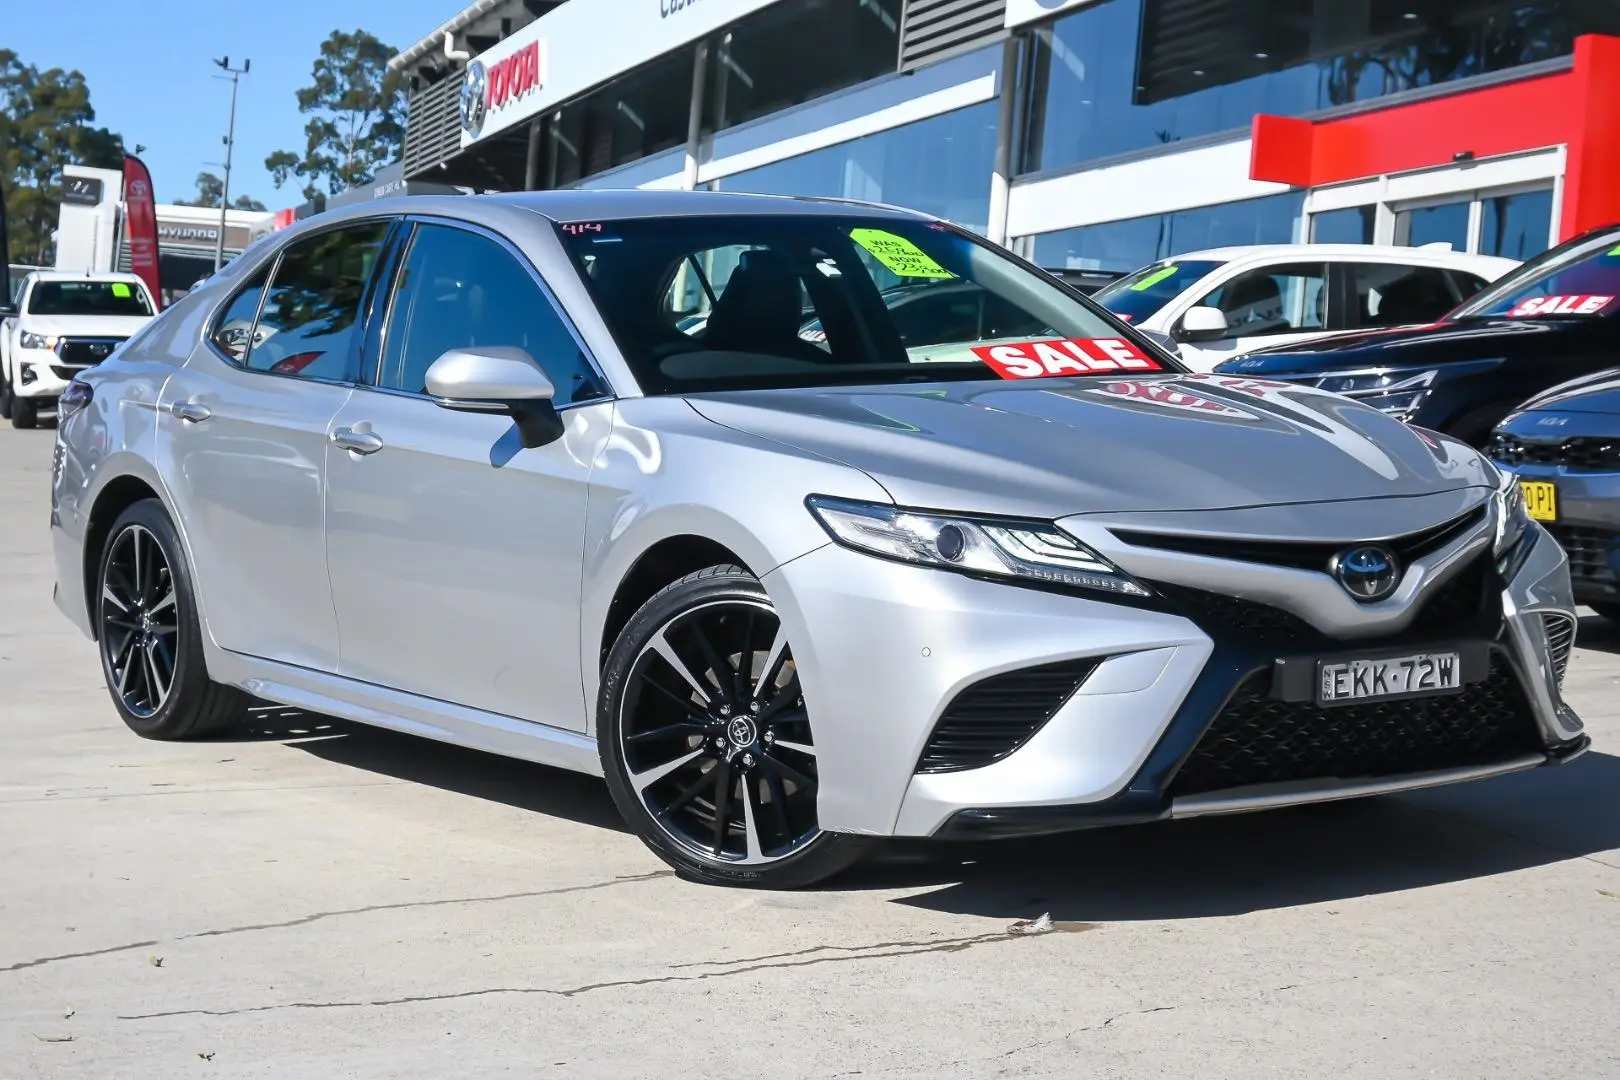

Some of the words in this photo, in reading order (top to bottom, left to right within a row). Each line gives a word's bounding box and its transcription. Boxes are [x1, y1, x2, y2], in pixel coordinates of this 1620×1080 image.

[486, 40, 539, 110] TOYOTA
[1513, 296, 1612, 316] SALE
[990, 339, 1150, 377] SALE
[1323, 668, 1333, 699] NSW
